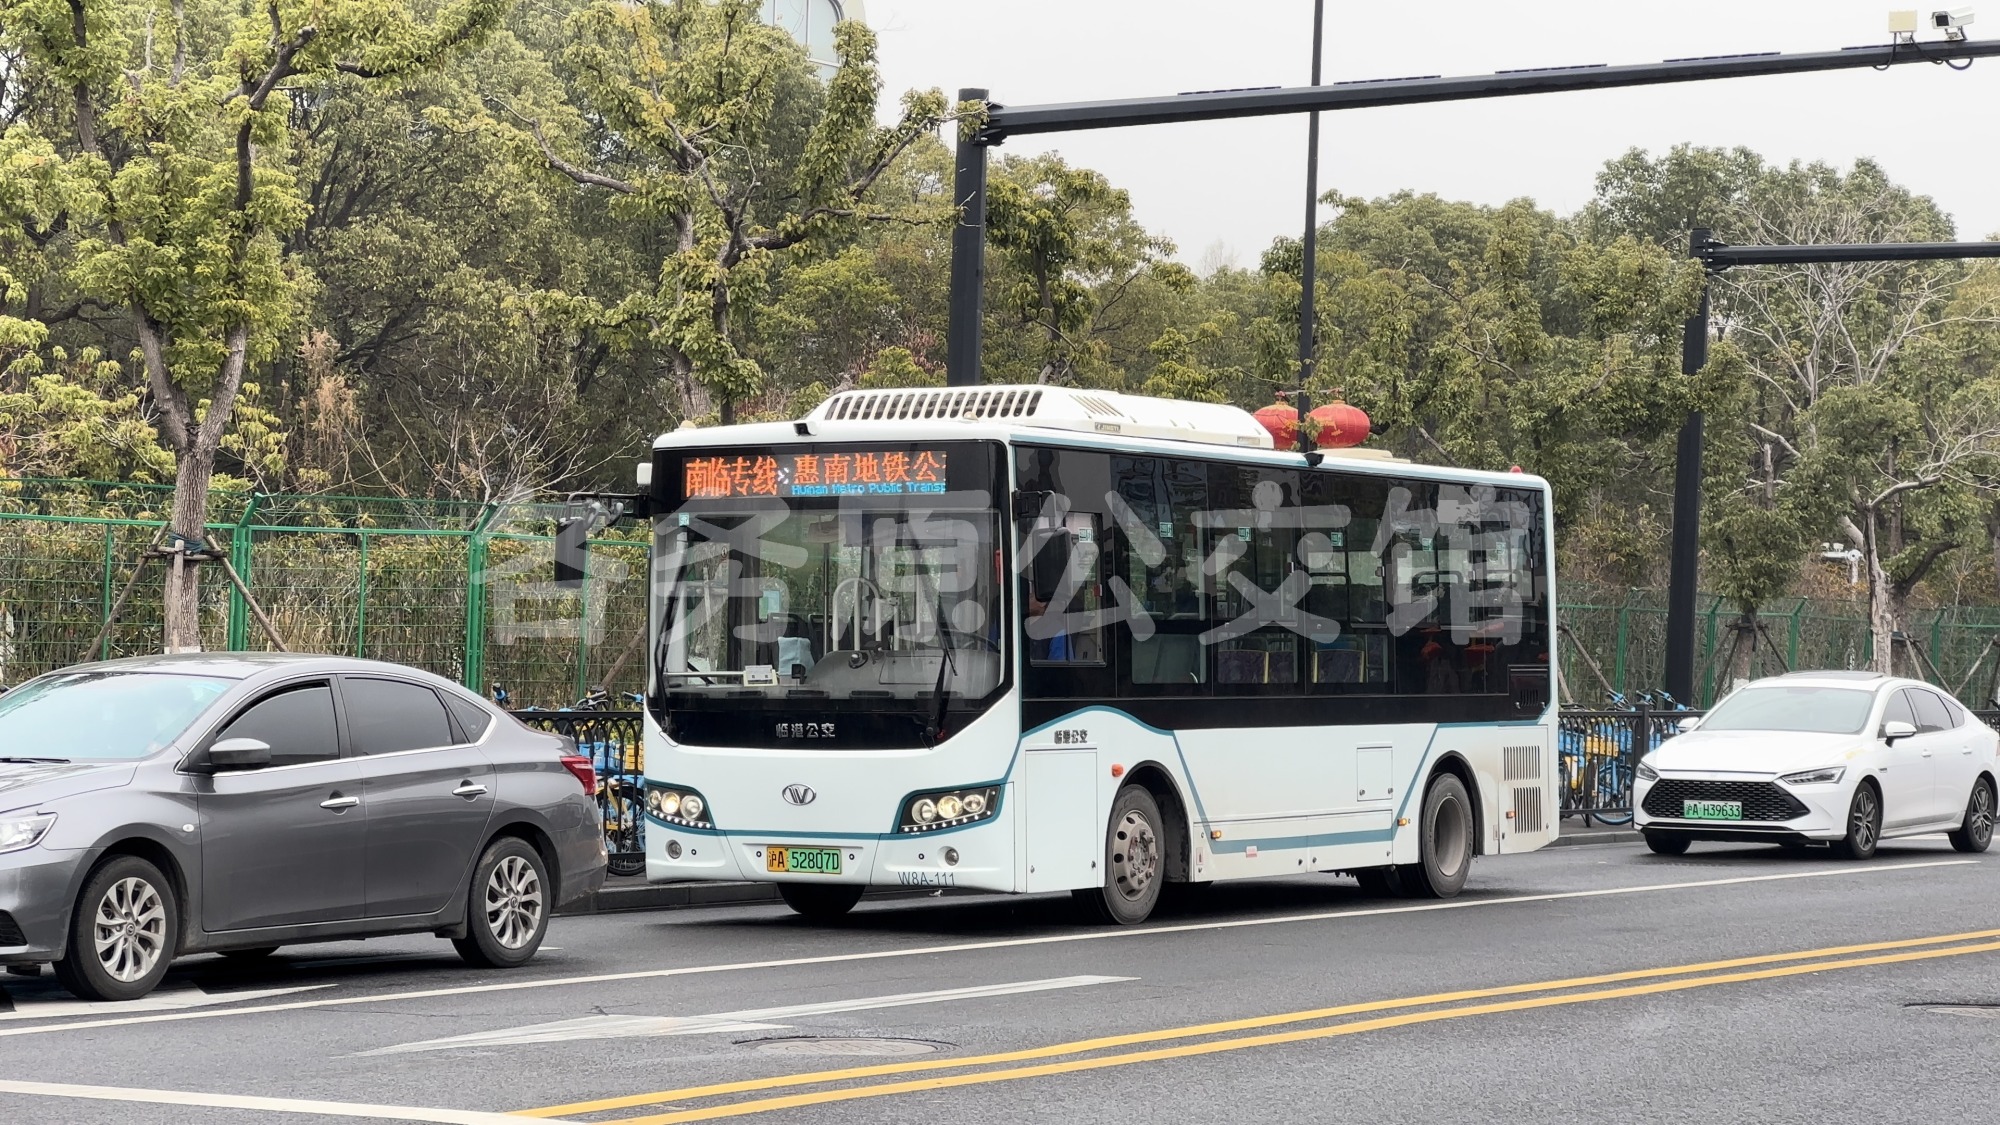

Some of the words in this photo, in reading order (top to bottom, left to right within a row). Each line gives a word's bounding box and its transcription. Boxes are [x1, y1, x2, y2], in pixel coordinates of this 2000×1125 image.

[686, 456, 778, 497] 南临专线
[793, 451, 947, 484] 惠南地铁公
[832, 483, 865, 494] Metro
[869, 482, 902, 493] Public
[776, 722, 836, 738] 临港公交
[897, 871, 955, 886] W8A-111
